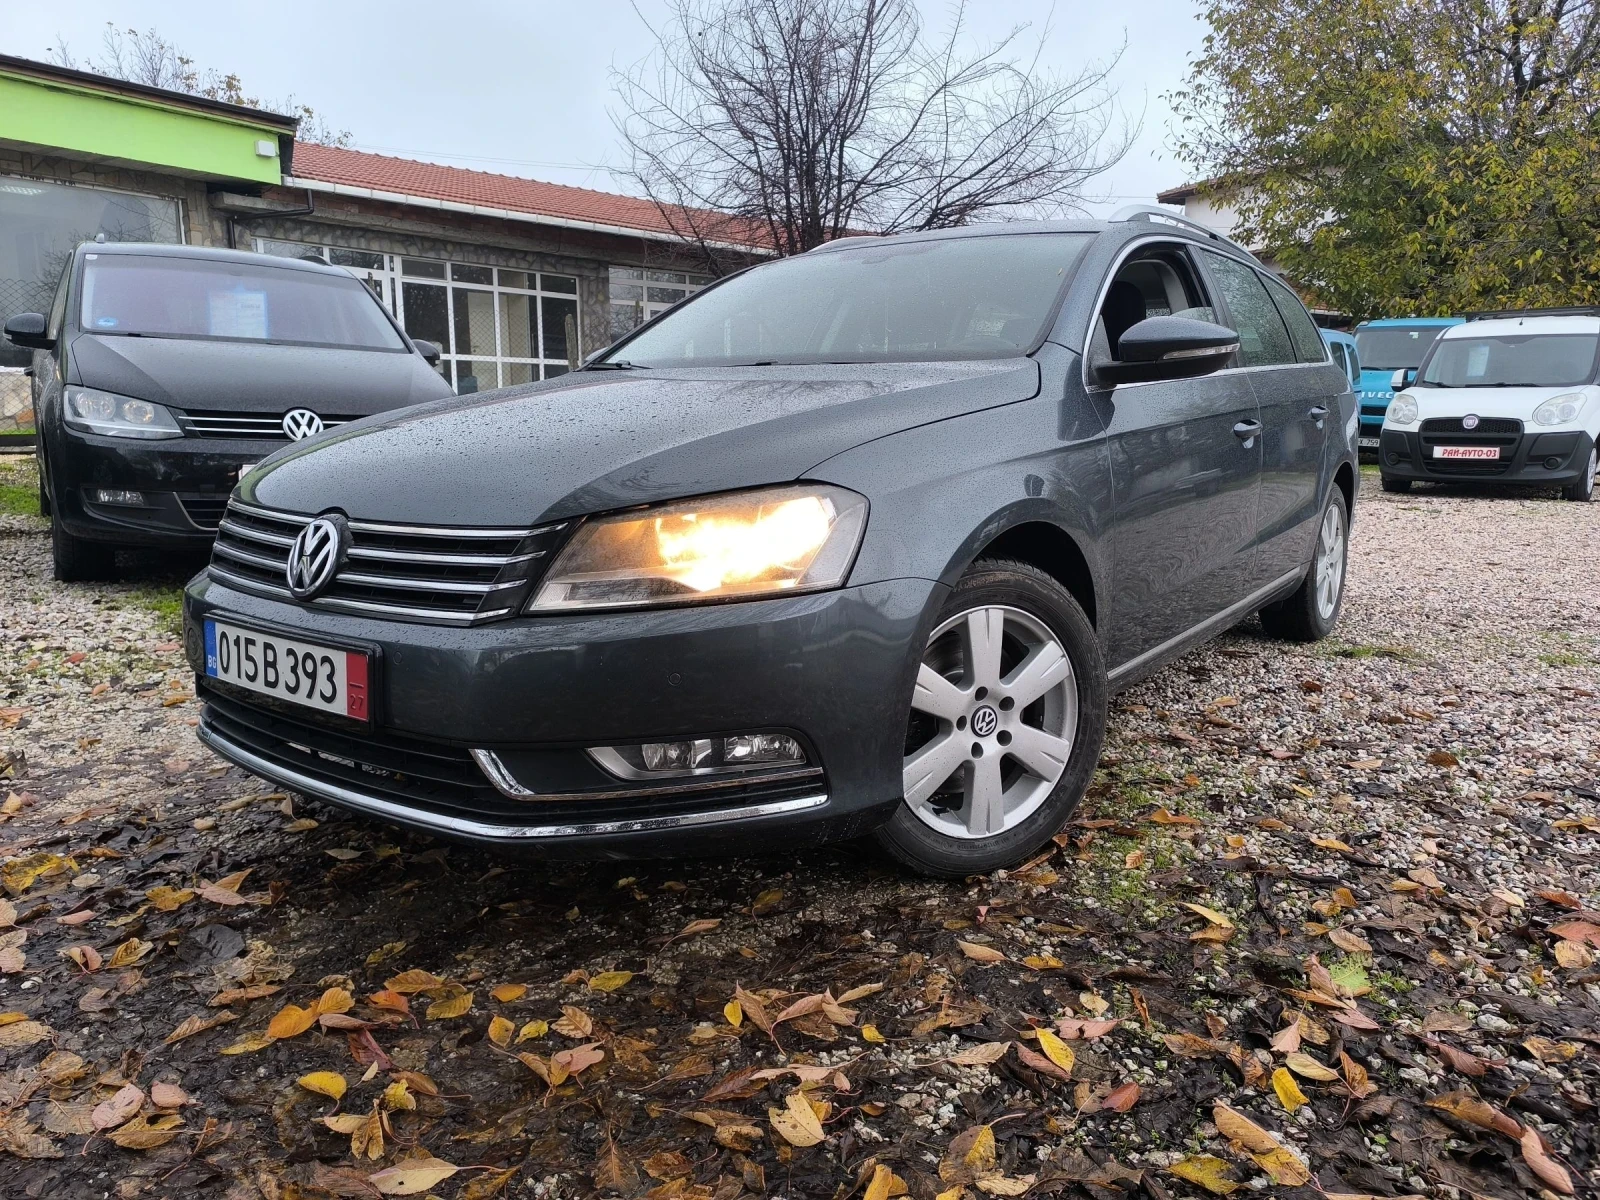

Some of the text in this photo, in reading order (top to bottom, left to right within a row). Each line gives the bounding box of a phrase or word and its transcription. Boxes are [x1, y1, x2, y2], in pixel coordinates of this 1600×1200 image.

[1361, 391, 1396, 399] IVEC
[207, 630, 338, 704] BG 015B393
[350, 693, 364, 711] 27
